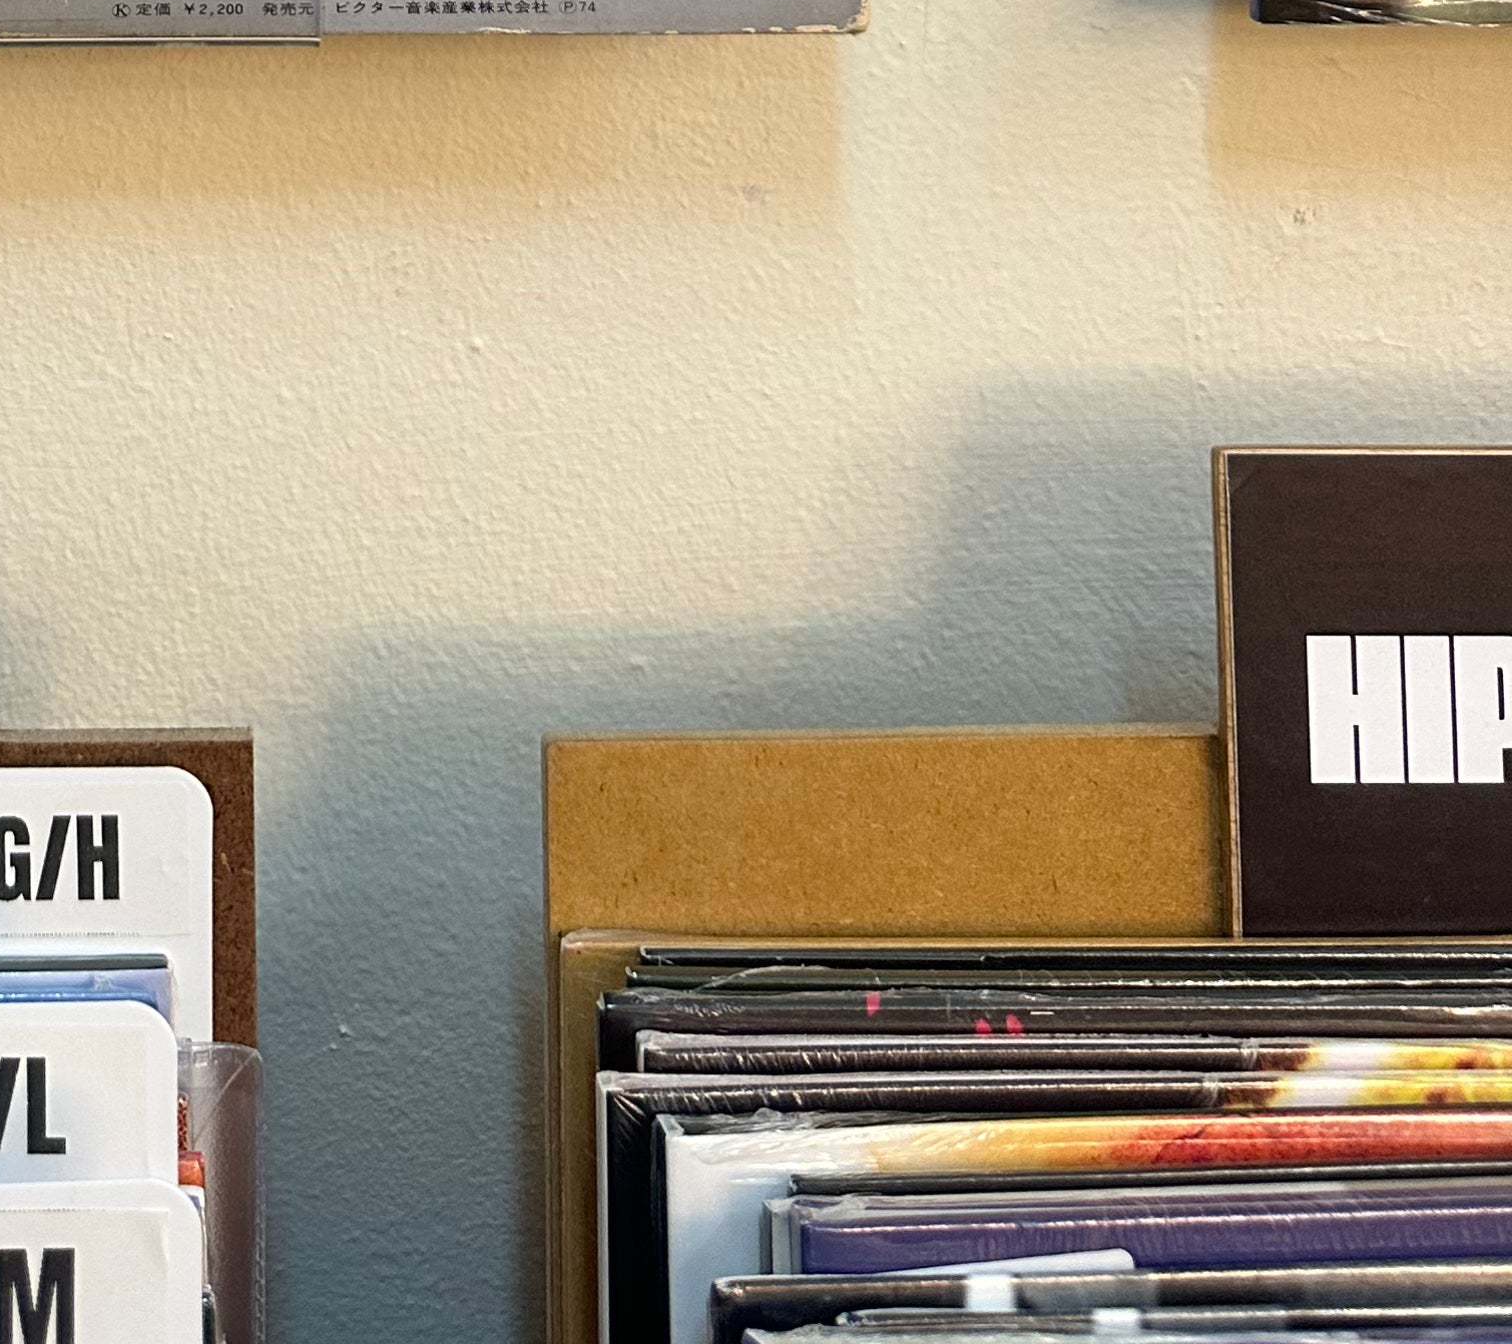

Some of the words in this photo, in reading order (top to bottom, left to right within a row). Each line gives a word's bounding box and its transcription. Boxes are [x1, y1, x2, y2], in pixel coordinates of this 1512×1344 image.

[136, 2, 172, 16] 定価
[262, 2, 315, 16] 発売元
